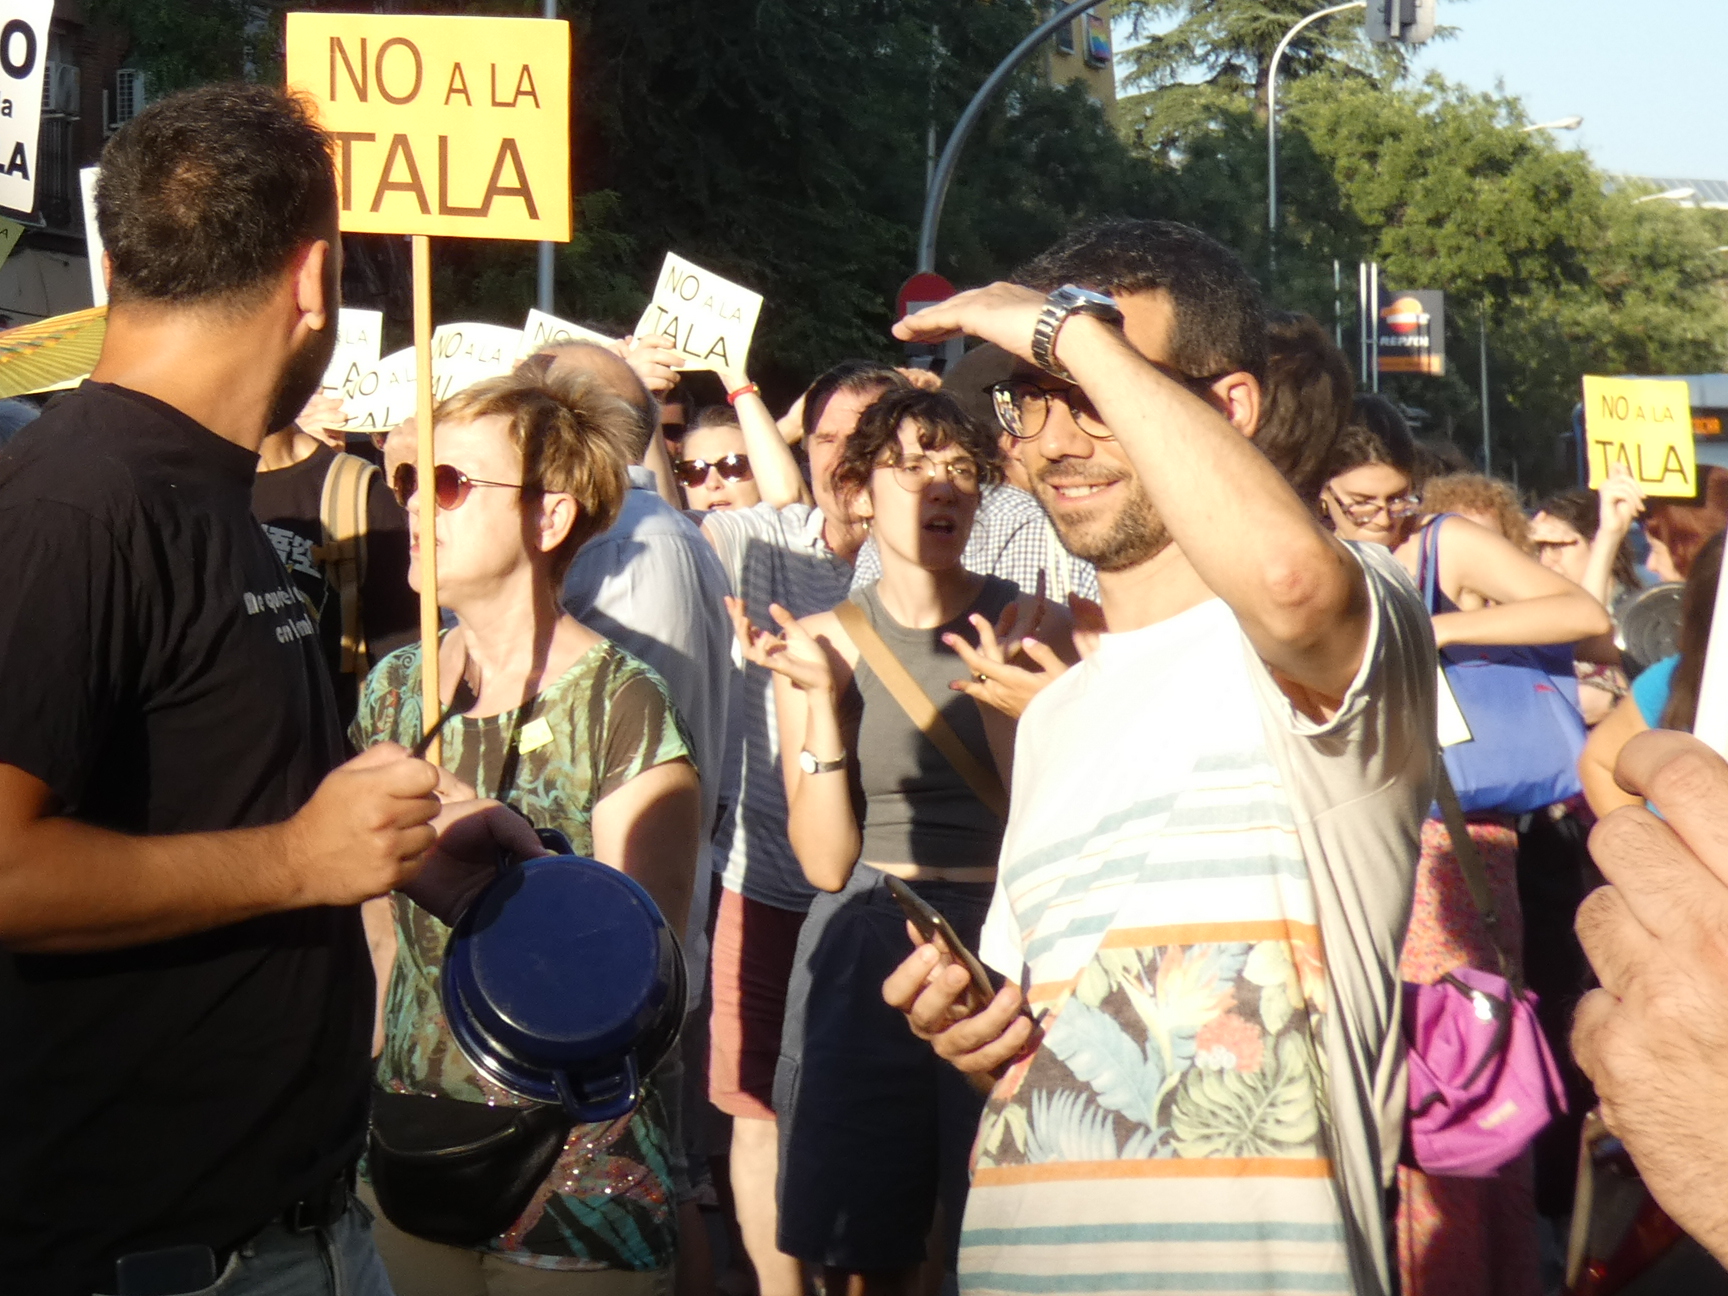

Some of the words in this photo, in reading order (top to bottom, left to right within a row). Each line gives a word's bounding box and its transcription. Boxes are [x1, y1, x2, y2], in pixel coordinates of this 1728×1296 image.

[329, 36, 423, 106] NO
[443, 61, 473, 107] A
[490, 62, 542, 110] LA
[326, 130, 541, 221] TALA
[664, 265, 700, 301] NO
[703, 295, 714, 313] A
[719, 301, 742, 324] LA
[432, 332, 463, 359] NO
[478, 347, 501, 365] LA
[651, 305, 730, 369] TALA
[1601, 394, 1629, 421] NO
[1635, 406, 1646, 422] A
[1653, 406, 1674, 423] LA
[1594, 439, 1689, 484] TALA
